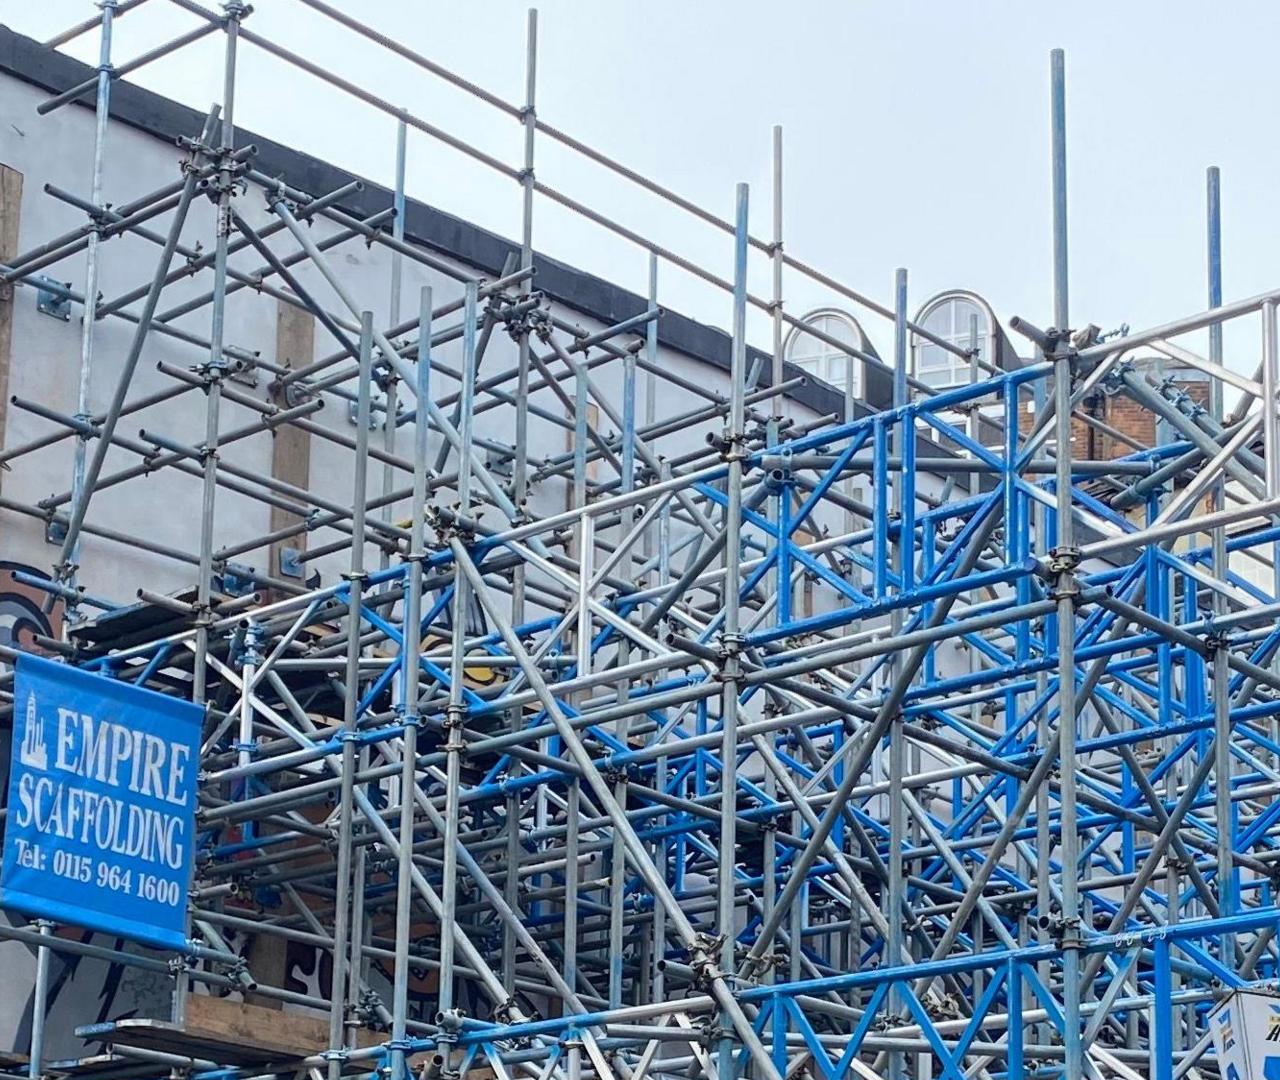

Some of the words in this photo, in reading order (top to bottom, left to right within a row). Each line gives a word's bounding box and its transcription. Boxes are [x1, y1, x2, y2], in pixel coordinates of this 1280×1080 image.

[55, 707, 190, 806] EMPIRE
[16, 772, 184, 869] SCAFFOLDING
[14, 838, 46, 871] Tel:
[53, 848, 92, 883] 0115
[97, 865, 132, 894] 964
[138, 871, 180, 906] 1600
